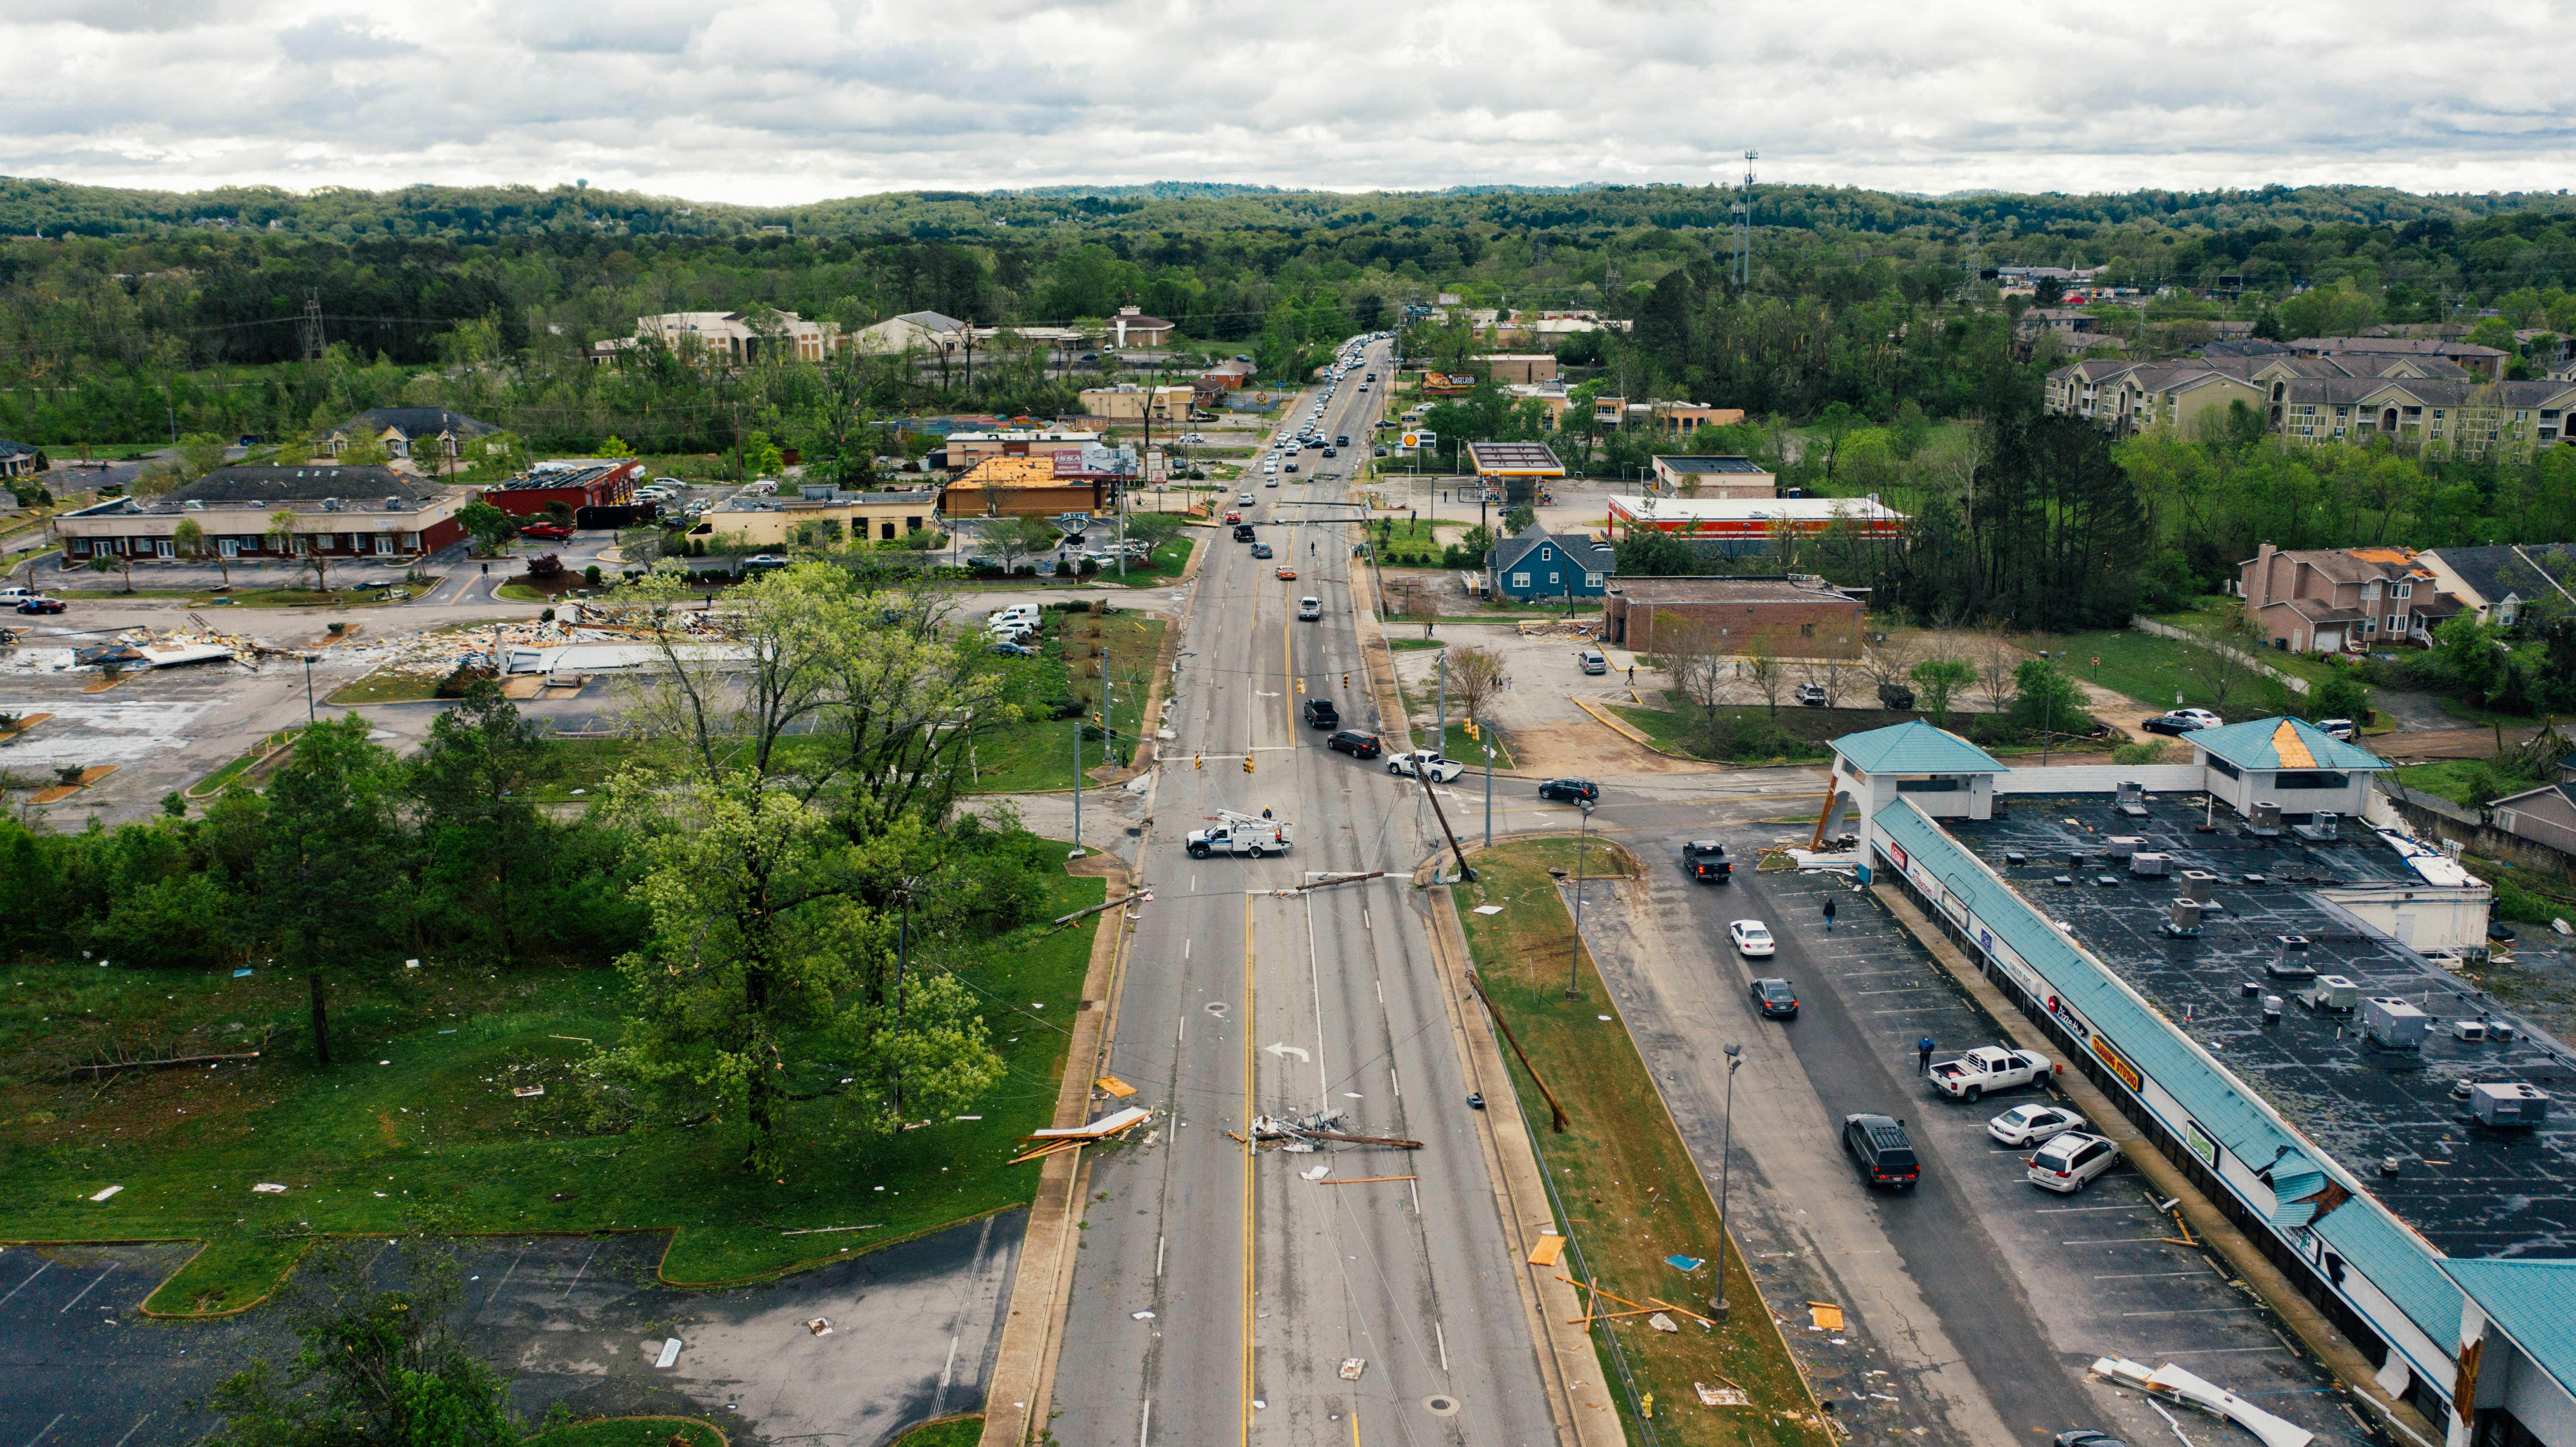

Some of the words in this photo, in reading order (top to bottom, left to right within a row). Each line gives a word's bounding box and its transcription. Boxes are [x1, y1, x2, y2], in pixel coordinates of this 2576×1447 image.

[1452, 376, 1474, 385] BAGELRITO
[1891, 848, 1905, 870] LOAN
[1912, 872, 1932, 896] ALTERATIONS
[2009, 962, 2023, 979] SALON
[2057, 1005, 2072, 1027] Pizza
[2073, 1020, 2084, 1037] Hut
[2093, 1039, 2115, 1068] TANNING
[2116, 1061, 2138, 1088] STUDIO
